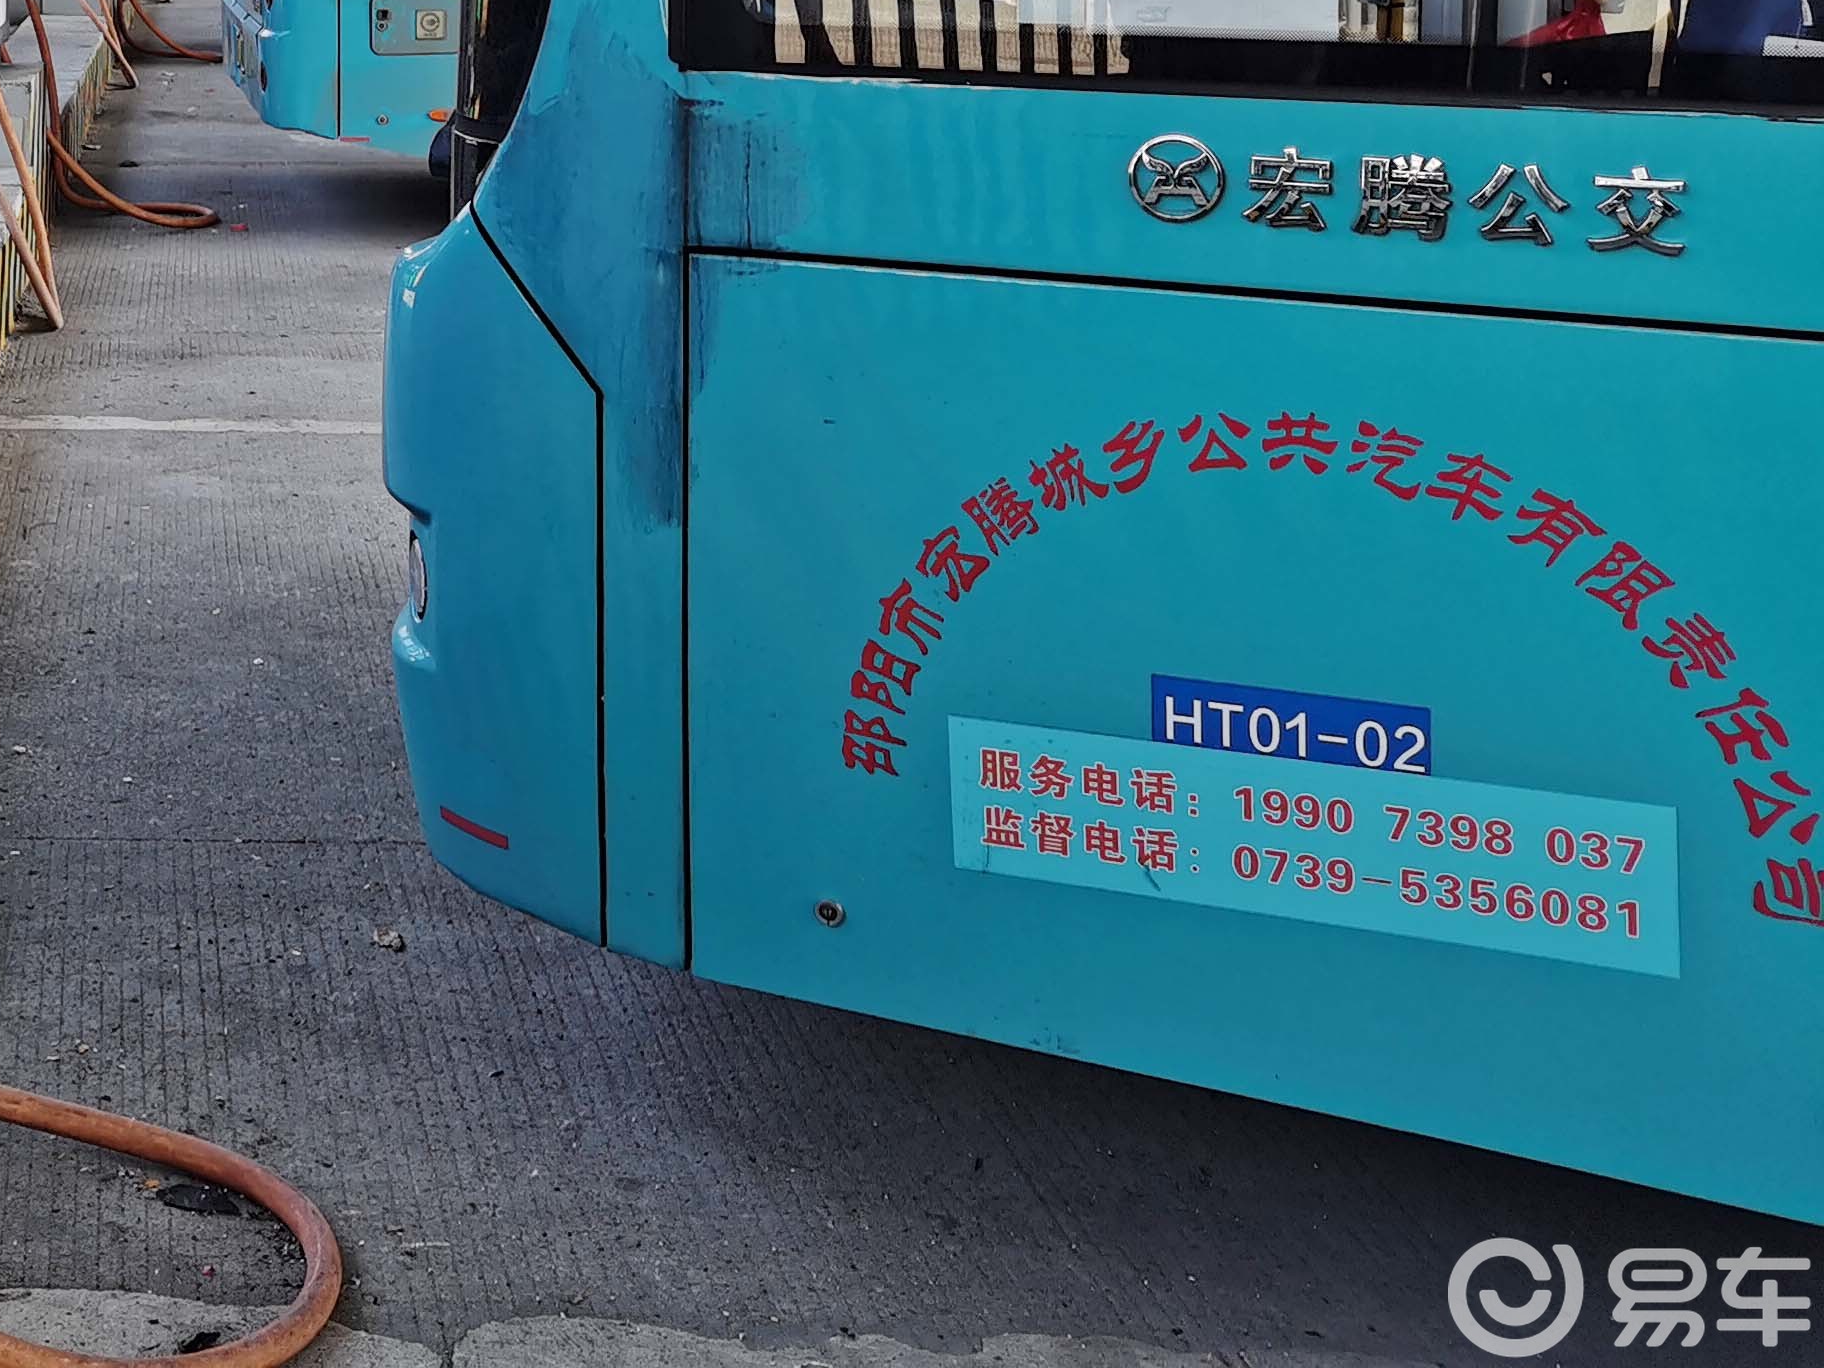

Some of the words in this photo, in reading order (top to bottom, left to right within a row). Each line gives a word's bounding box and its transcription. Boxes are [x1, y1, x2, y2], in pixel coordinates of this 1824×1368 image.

[1241, 145, 1688, 256] 宏腾公交
[842, 411, 1824, 929] 邵阳市宏腾城乡公共汽车有限责任公司
[1164, 696, 1426, 774] HT01-02
[979, 747, 1200, 818] 服务电话：
[1233, 785, 1355, 835] 1990
[1383, 804, 1515, 857] 7398
[1545, 826, 1646, 874] 037
[982, 806, 1200, 875] 监督电话：
[1232, 845, 1641, 939] 0739-5356081
